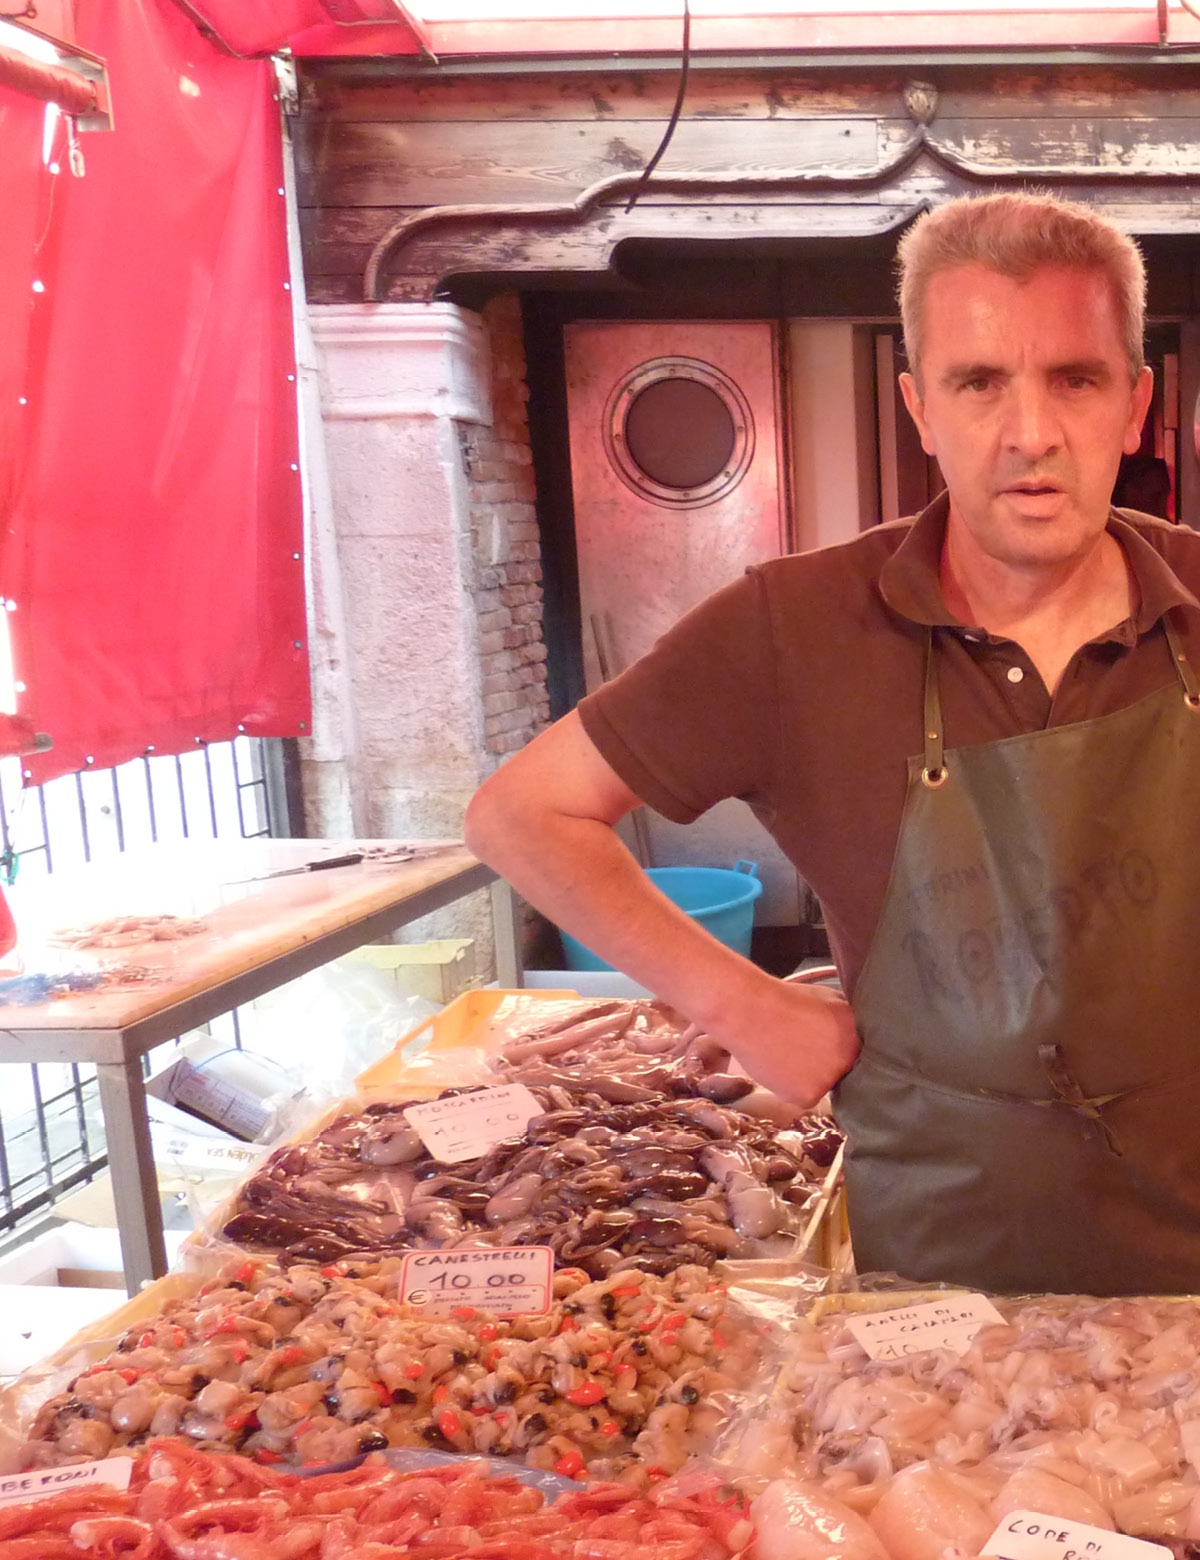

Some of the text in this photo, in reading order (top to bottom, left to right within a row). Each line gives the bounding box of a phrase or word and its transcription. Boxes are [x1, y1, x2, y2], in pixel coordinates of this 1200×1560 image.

[414, 1251, 537, 1267] CANESTRELLI
[934, 1308, 951, 1316] DI
[1007, 1519, 1070, 1543] CODE
